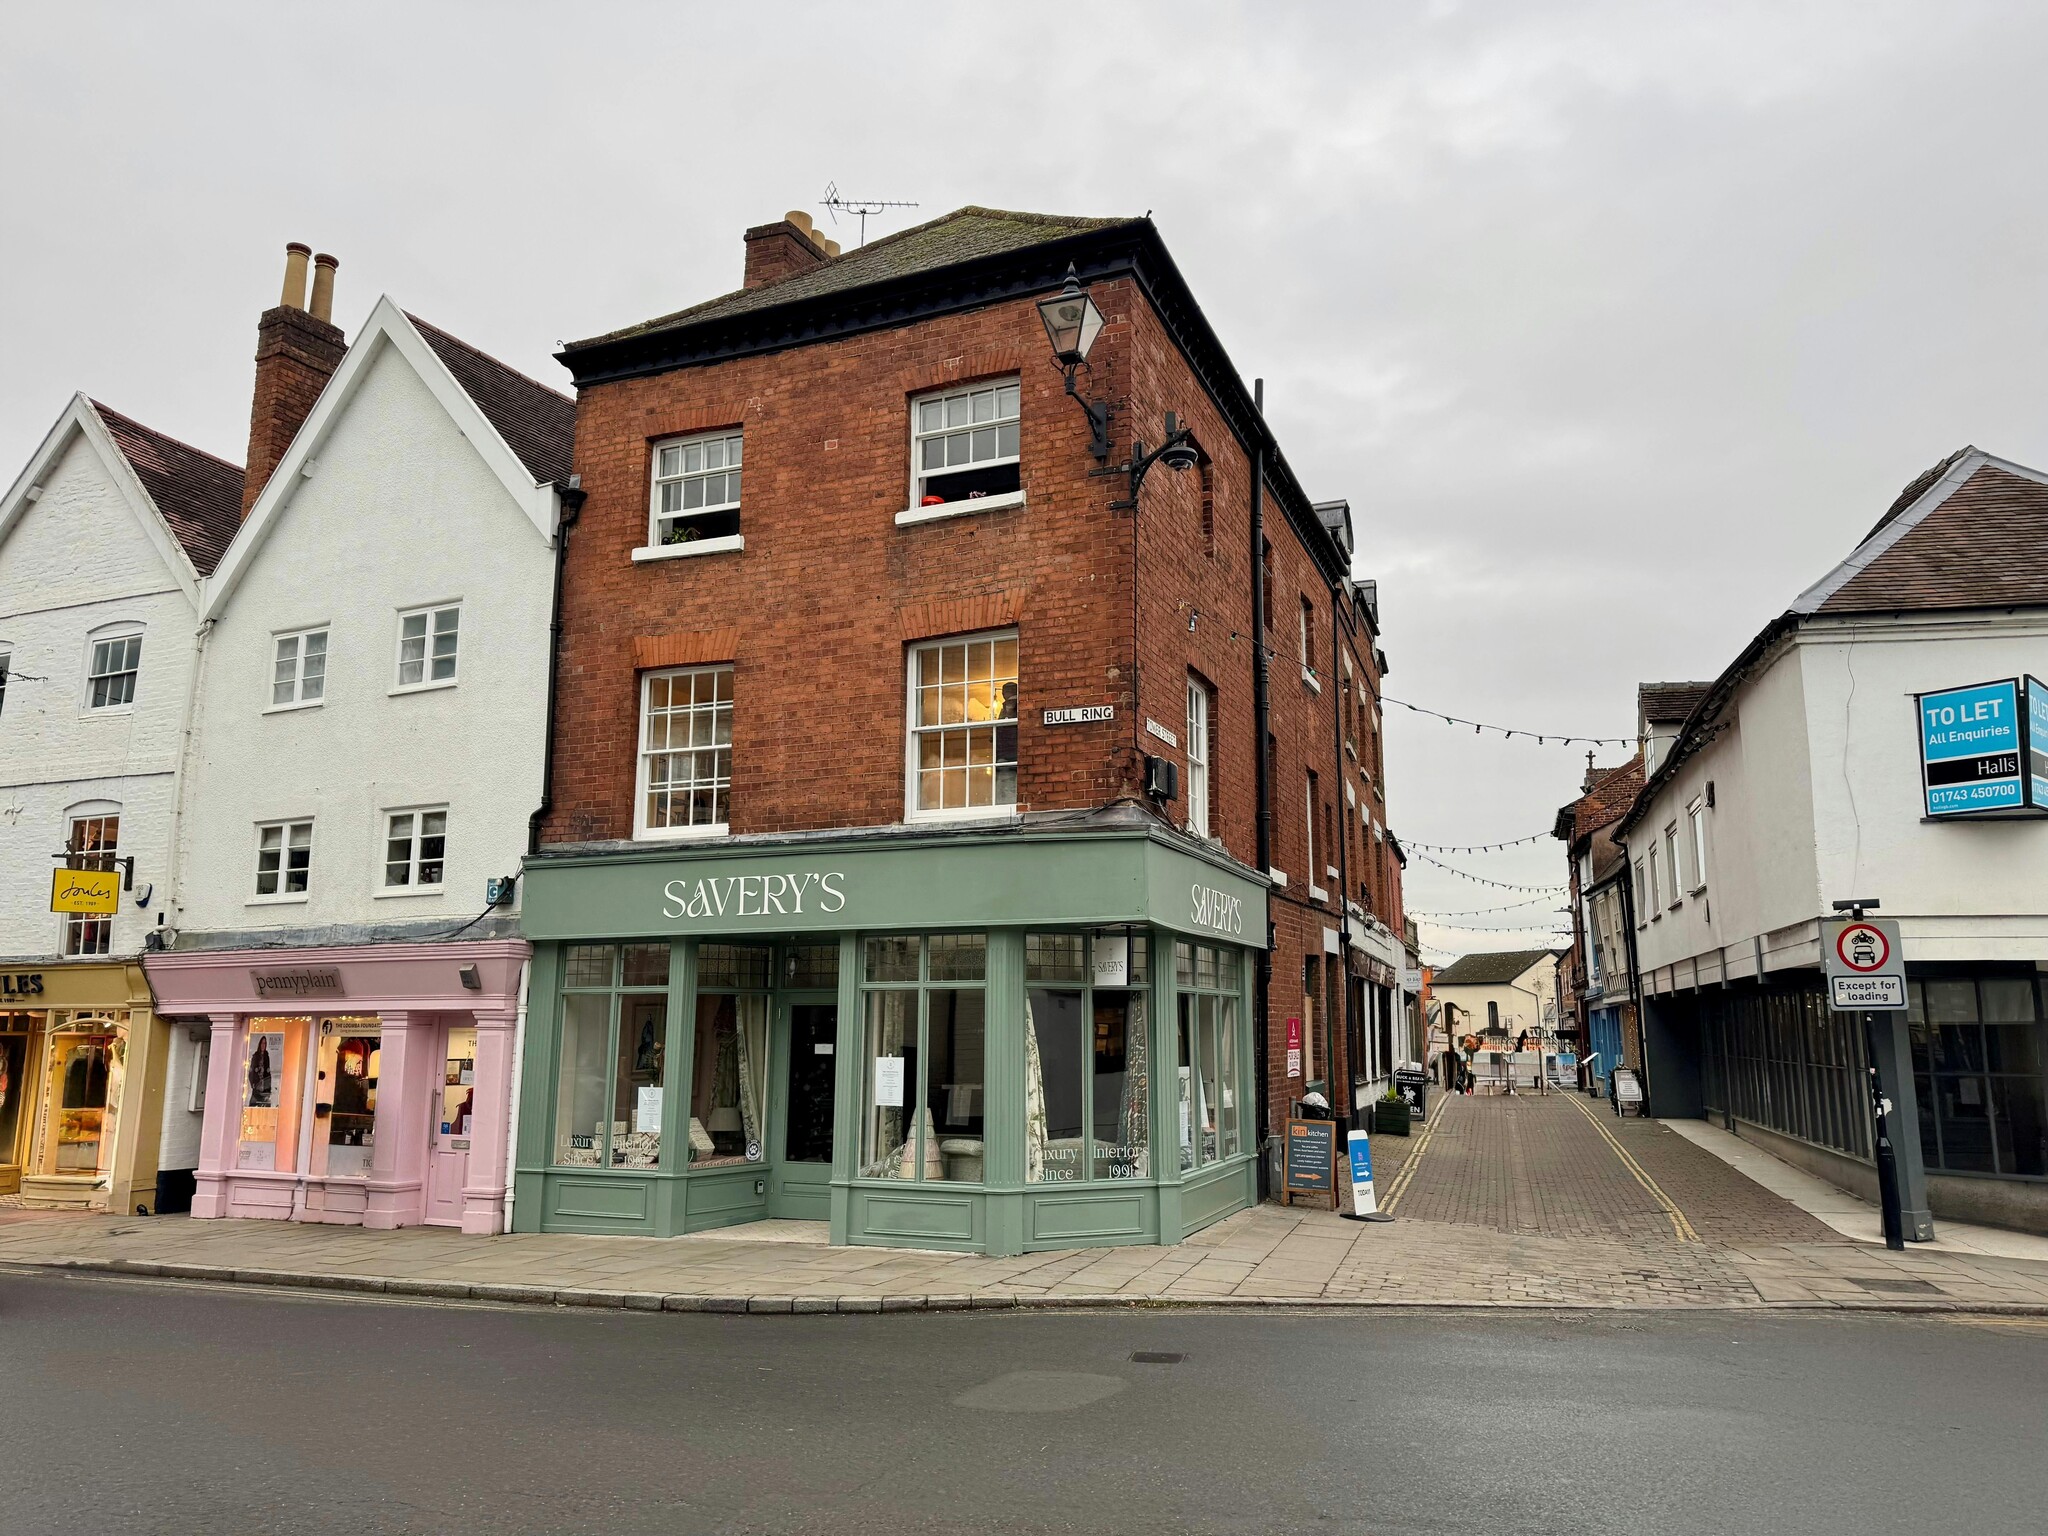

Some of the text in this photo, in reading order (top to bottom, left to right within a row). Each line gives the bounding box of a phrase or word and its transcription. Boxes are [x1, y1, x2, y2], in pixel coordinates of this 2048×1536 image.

[1046, 707, 1112, 723] BULL RING
[1926, 699, 2003, 727] TO LET
[1147, 718, 1176, 745] TOWER STREET
[1929, 726, 2010, 745] All Enquiries
[1978, 758, 2016, 775] Halls
[1932, 784, 2015, 803] 01743 450700
[60, 876, 110, 899] joules
[663, 872, 846, 919] SAVERY'S
[1191, 884, 1242, 934] SAVERY'S
[1838, 980, 1896, 991] Except for
[1848, 992, 1889, 1001] loading
[1293, 1127, 1329, 1138] kin kitchen
[1042, 1145, 1149, 1164] uxury Interiors
[1108, 1164, 1134, 1179] 1991
